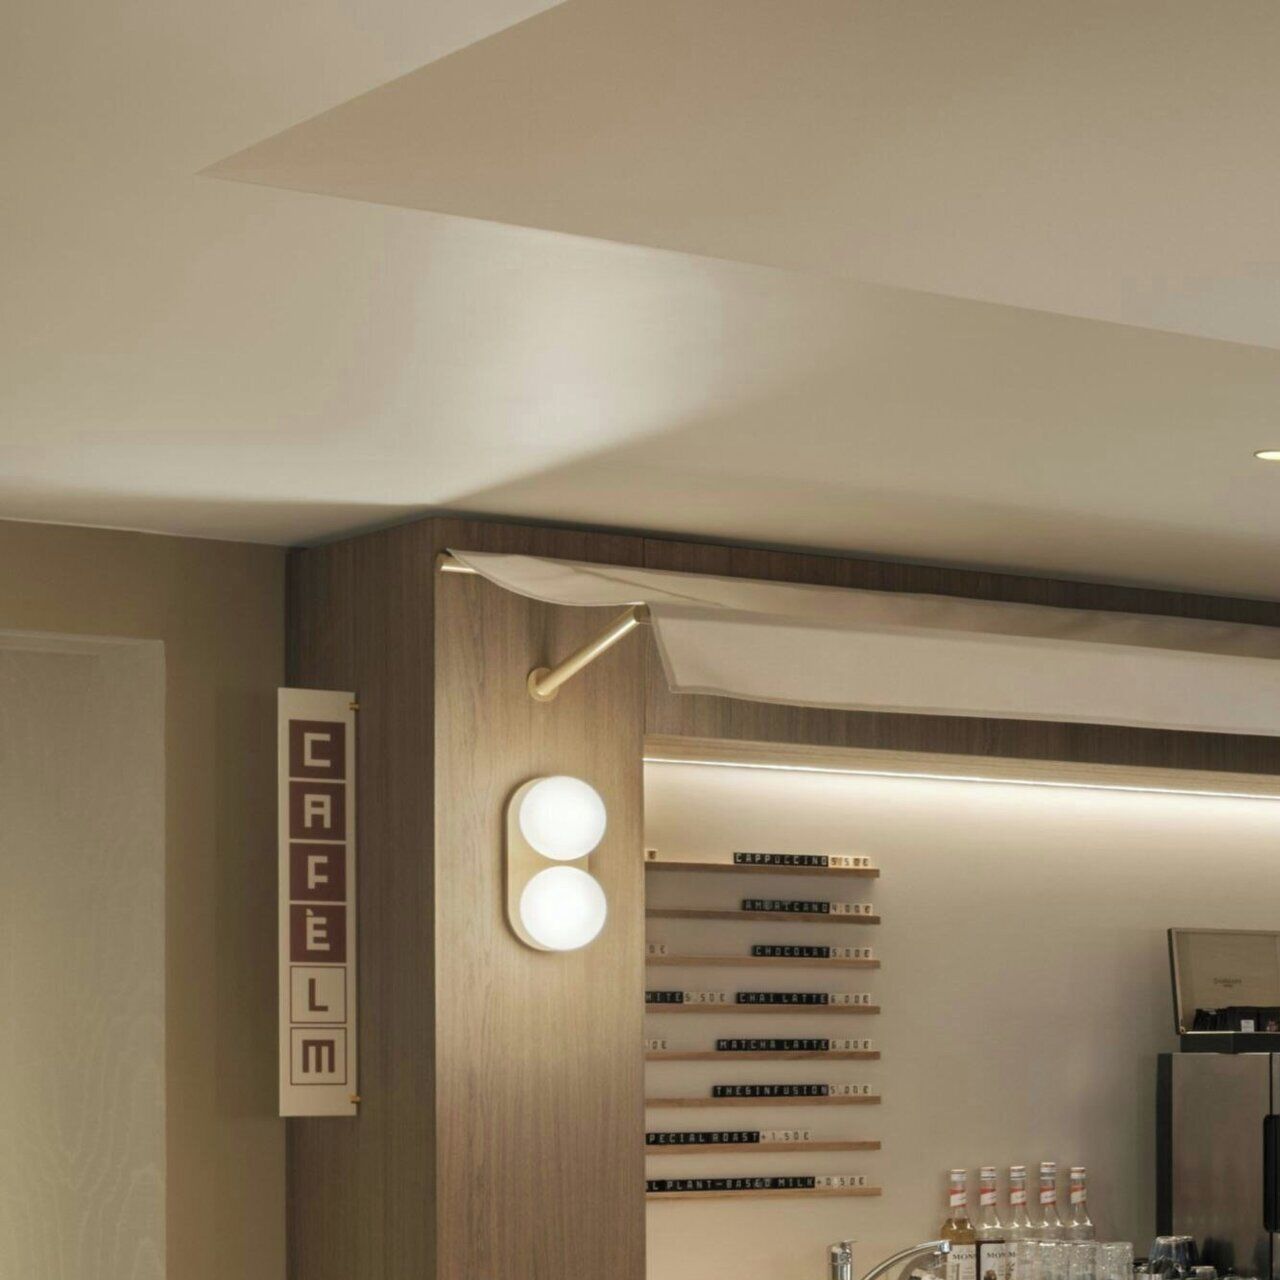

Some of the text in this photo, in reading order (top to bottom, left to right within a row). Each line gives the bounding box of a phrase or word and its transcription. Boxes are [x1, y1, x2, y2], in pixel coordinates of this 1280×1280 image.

[735, 853, 829, 866] CAPPUCCINO
[755, 946, 828, 958] CHOCOLAT
[739, 993, 775, 1004] CHAI
[781, 993, 828, 1004] LATTE
[719, 1040, 777, 1050] MATCHA
[783, 1040, 828, 1050] LATTE
[711, 1131, 759, 1143] ROAST
[777, 1176, 815, 1188] MILK
